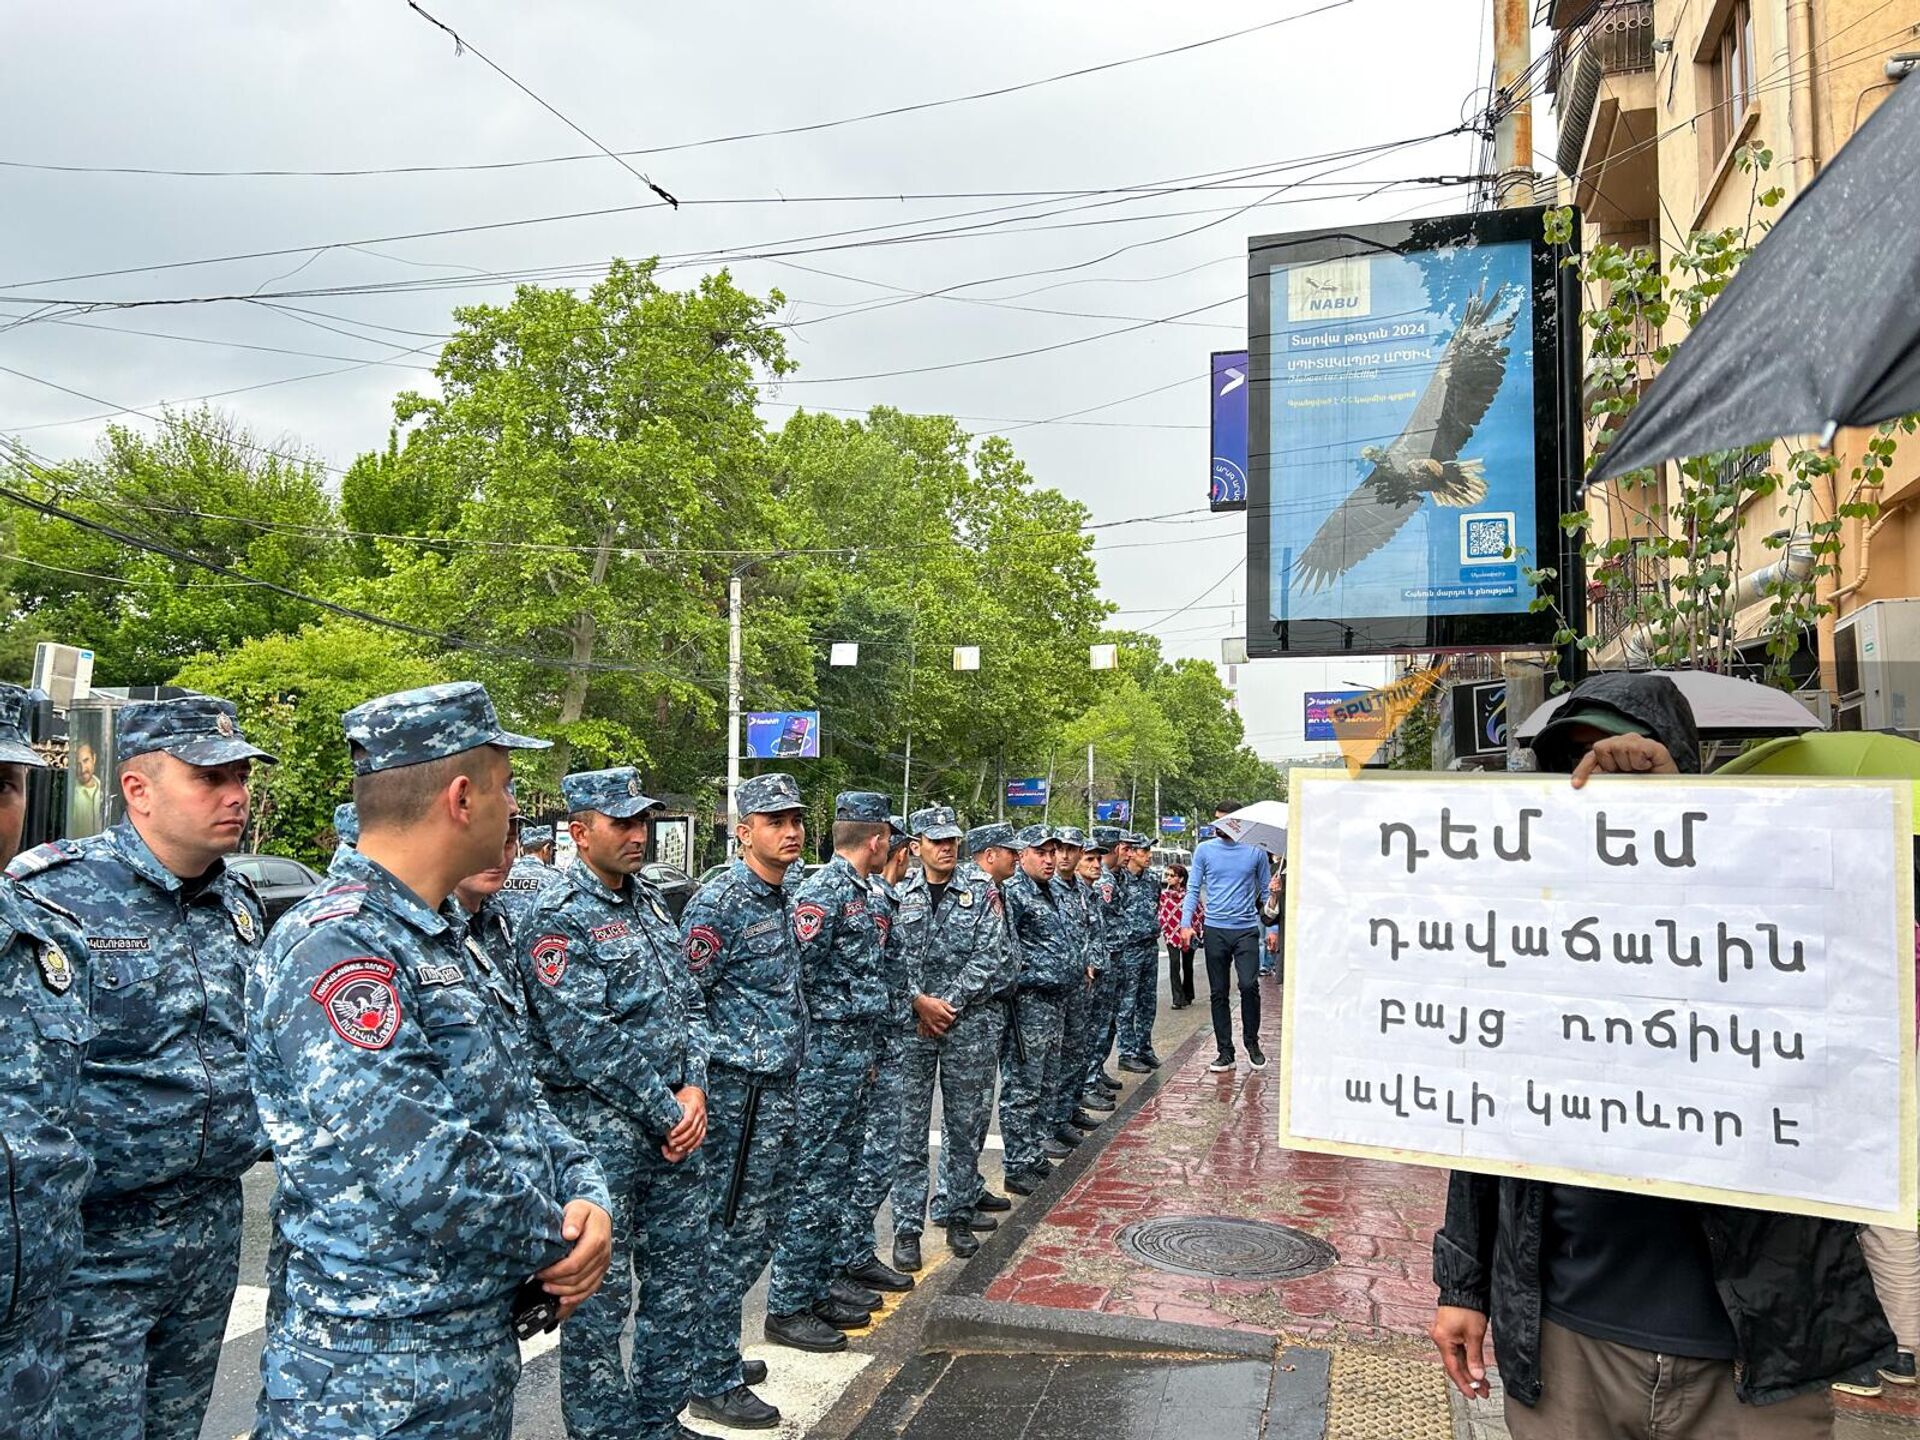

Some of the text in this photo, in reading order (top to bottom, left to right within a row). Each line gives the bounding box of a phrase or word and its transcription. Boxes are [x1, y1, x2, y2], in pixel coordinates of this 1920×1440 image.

[1310, 297, 1358, 310] NABU
[1292, 324, 1424, 347] Տարվա թռչուն 2024
[1287, 349, 1431, 371] ՍՊԻՏԱԿԱՊՈՉ ԱՐԾԻՎ
[1380, 808, 1708, 873] դեմ եմ
[502, 879, 538, 890] OLICE
[595, 925, 625, 939] POLICE
[88, 939, 147, 949] ԿԱՆՈՒԹՅՈՒՆ
[1369, 910, 1806, 983] դավաճանին
[1380, 998, 1805, 1069] բայց ռոճիկս
[1345, 1073, 1800, 1147] ավելի կարևոր է
